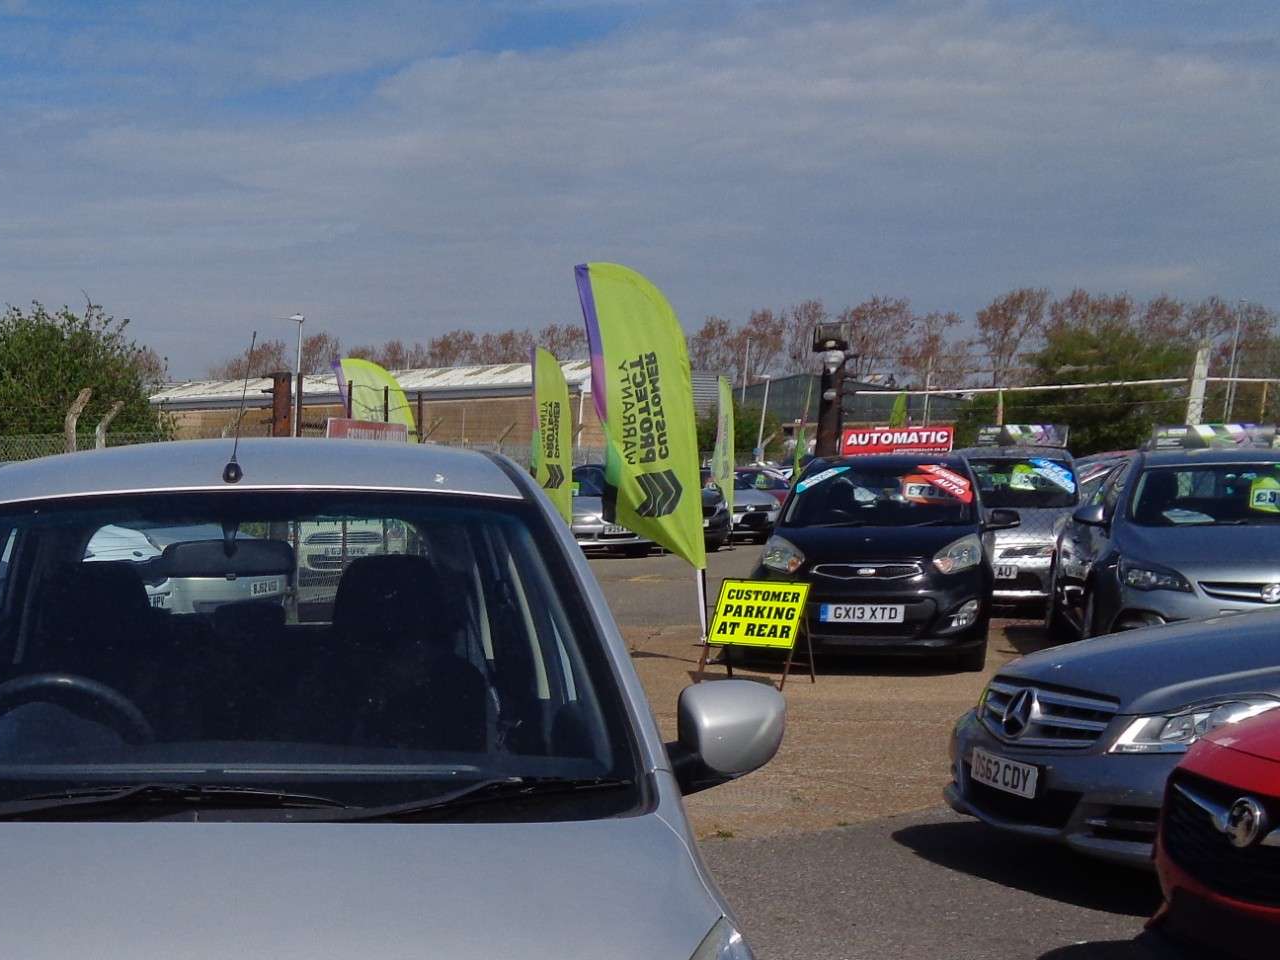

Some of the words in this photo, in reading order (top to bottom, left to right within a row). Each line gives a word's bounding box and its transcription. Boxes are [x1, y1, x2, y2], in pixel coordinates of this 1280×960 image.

[846, 430, 949, 446] AUTOMATIC
[934, 479, 965, 495] AUTO
[727, 588, 801, 603] CUSTOMER
[722, 603, 796, 621] PARKING
[832, 606, 865, 620] GX13
[870, 606, 899, 620] XTD
[716, 621, 740, 636] AT
[744, 622, 792, 639] REAR
[1002, 763, 1031, 792] CDY
